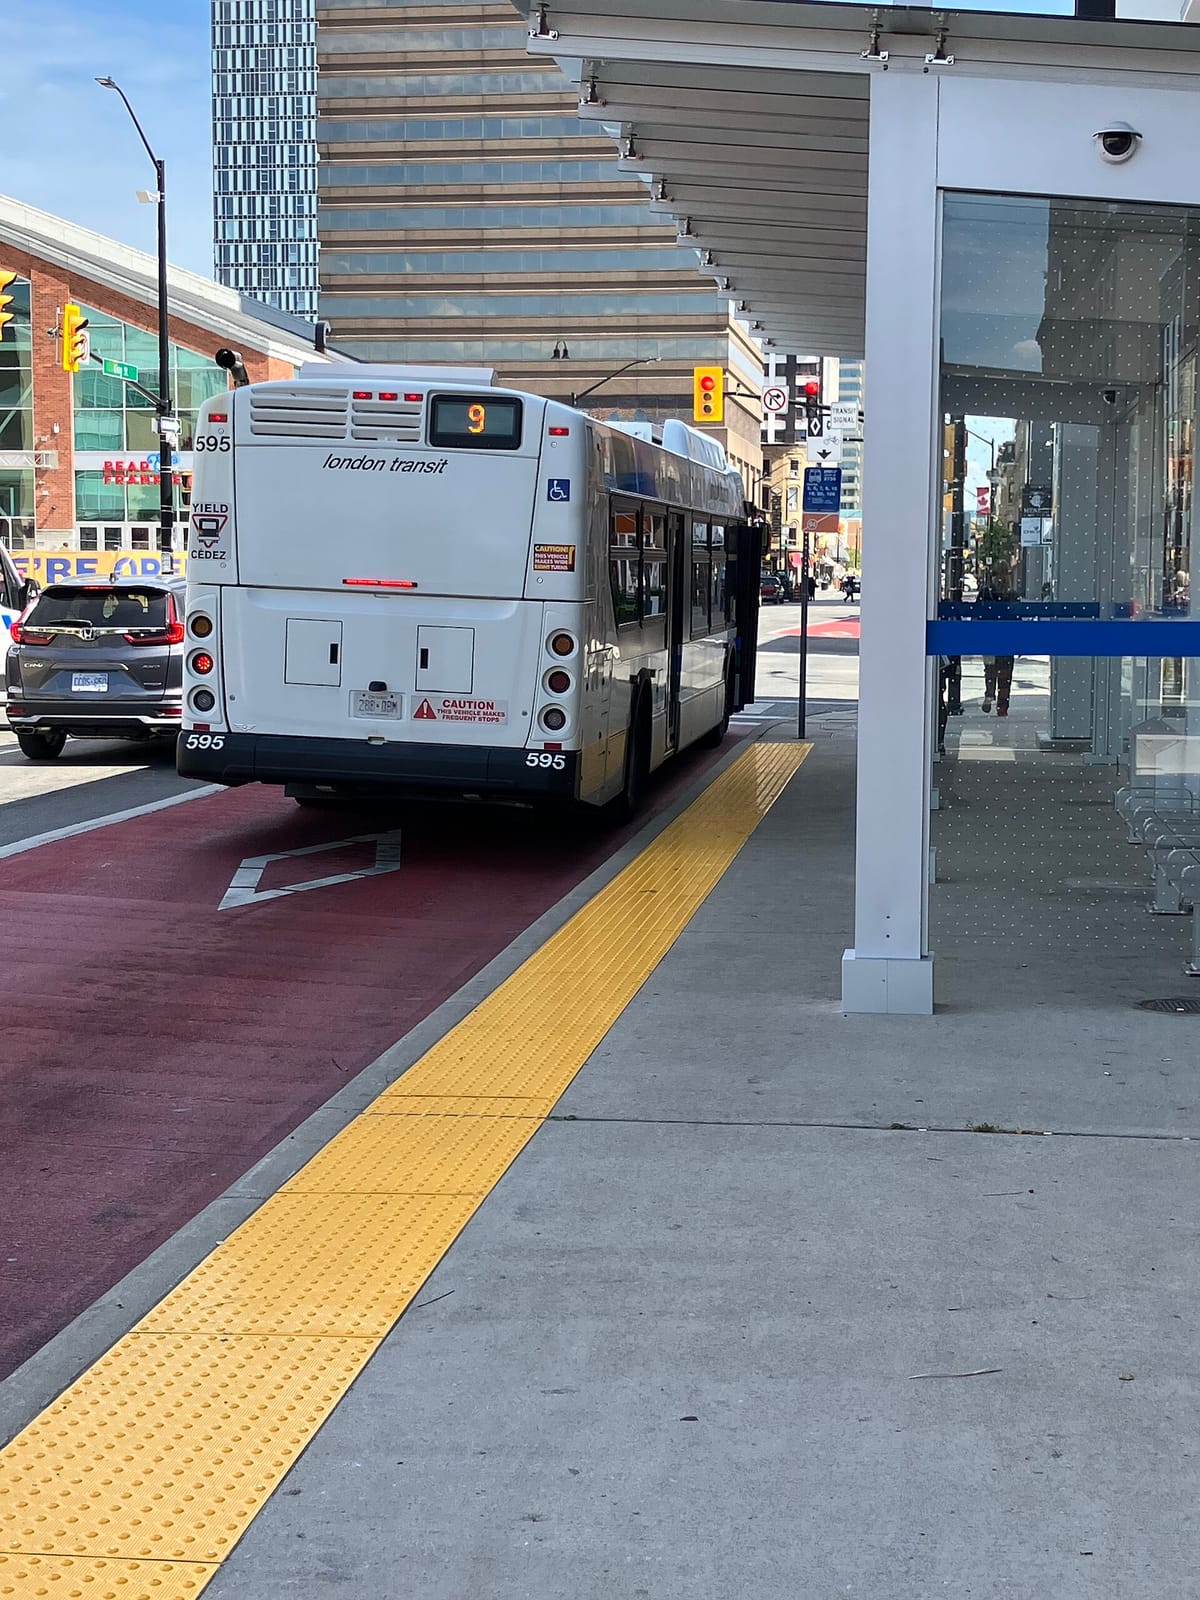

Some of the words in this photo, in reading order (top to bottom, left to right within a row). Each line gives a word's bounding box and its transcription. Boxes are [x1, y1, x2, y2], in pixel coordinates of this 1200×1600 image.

[467, 404, 485, 433] 9
[195, 435, 231, 452] 595
[323, 453, 386, 472] london
[389, 456, 449, 474] transit
[192, 503, 229, 513] YIELD
[191, 547, 227, 560] CÉDEZ
[442, 699, 495, 711] CAUTION
[185, 734, 226, 750] 595
[525, 752, 566, 770] 595
